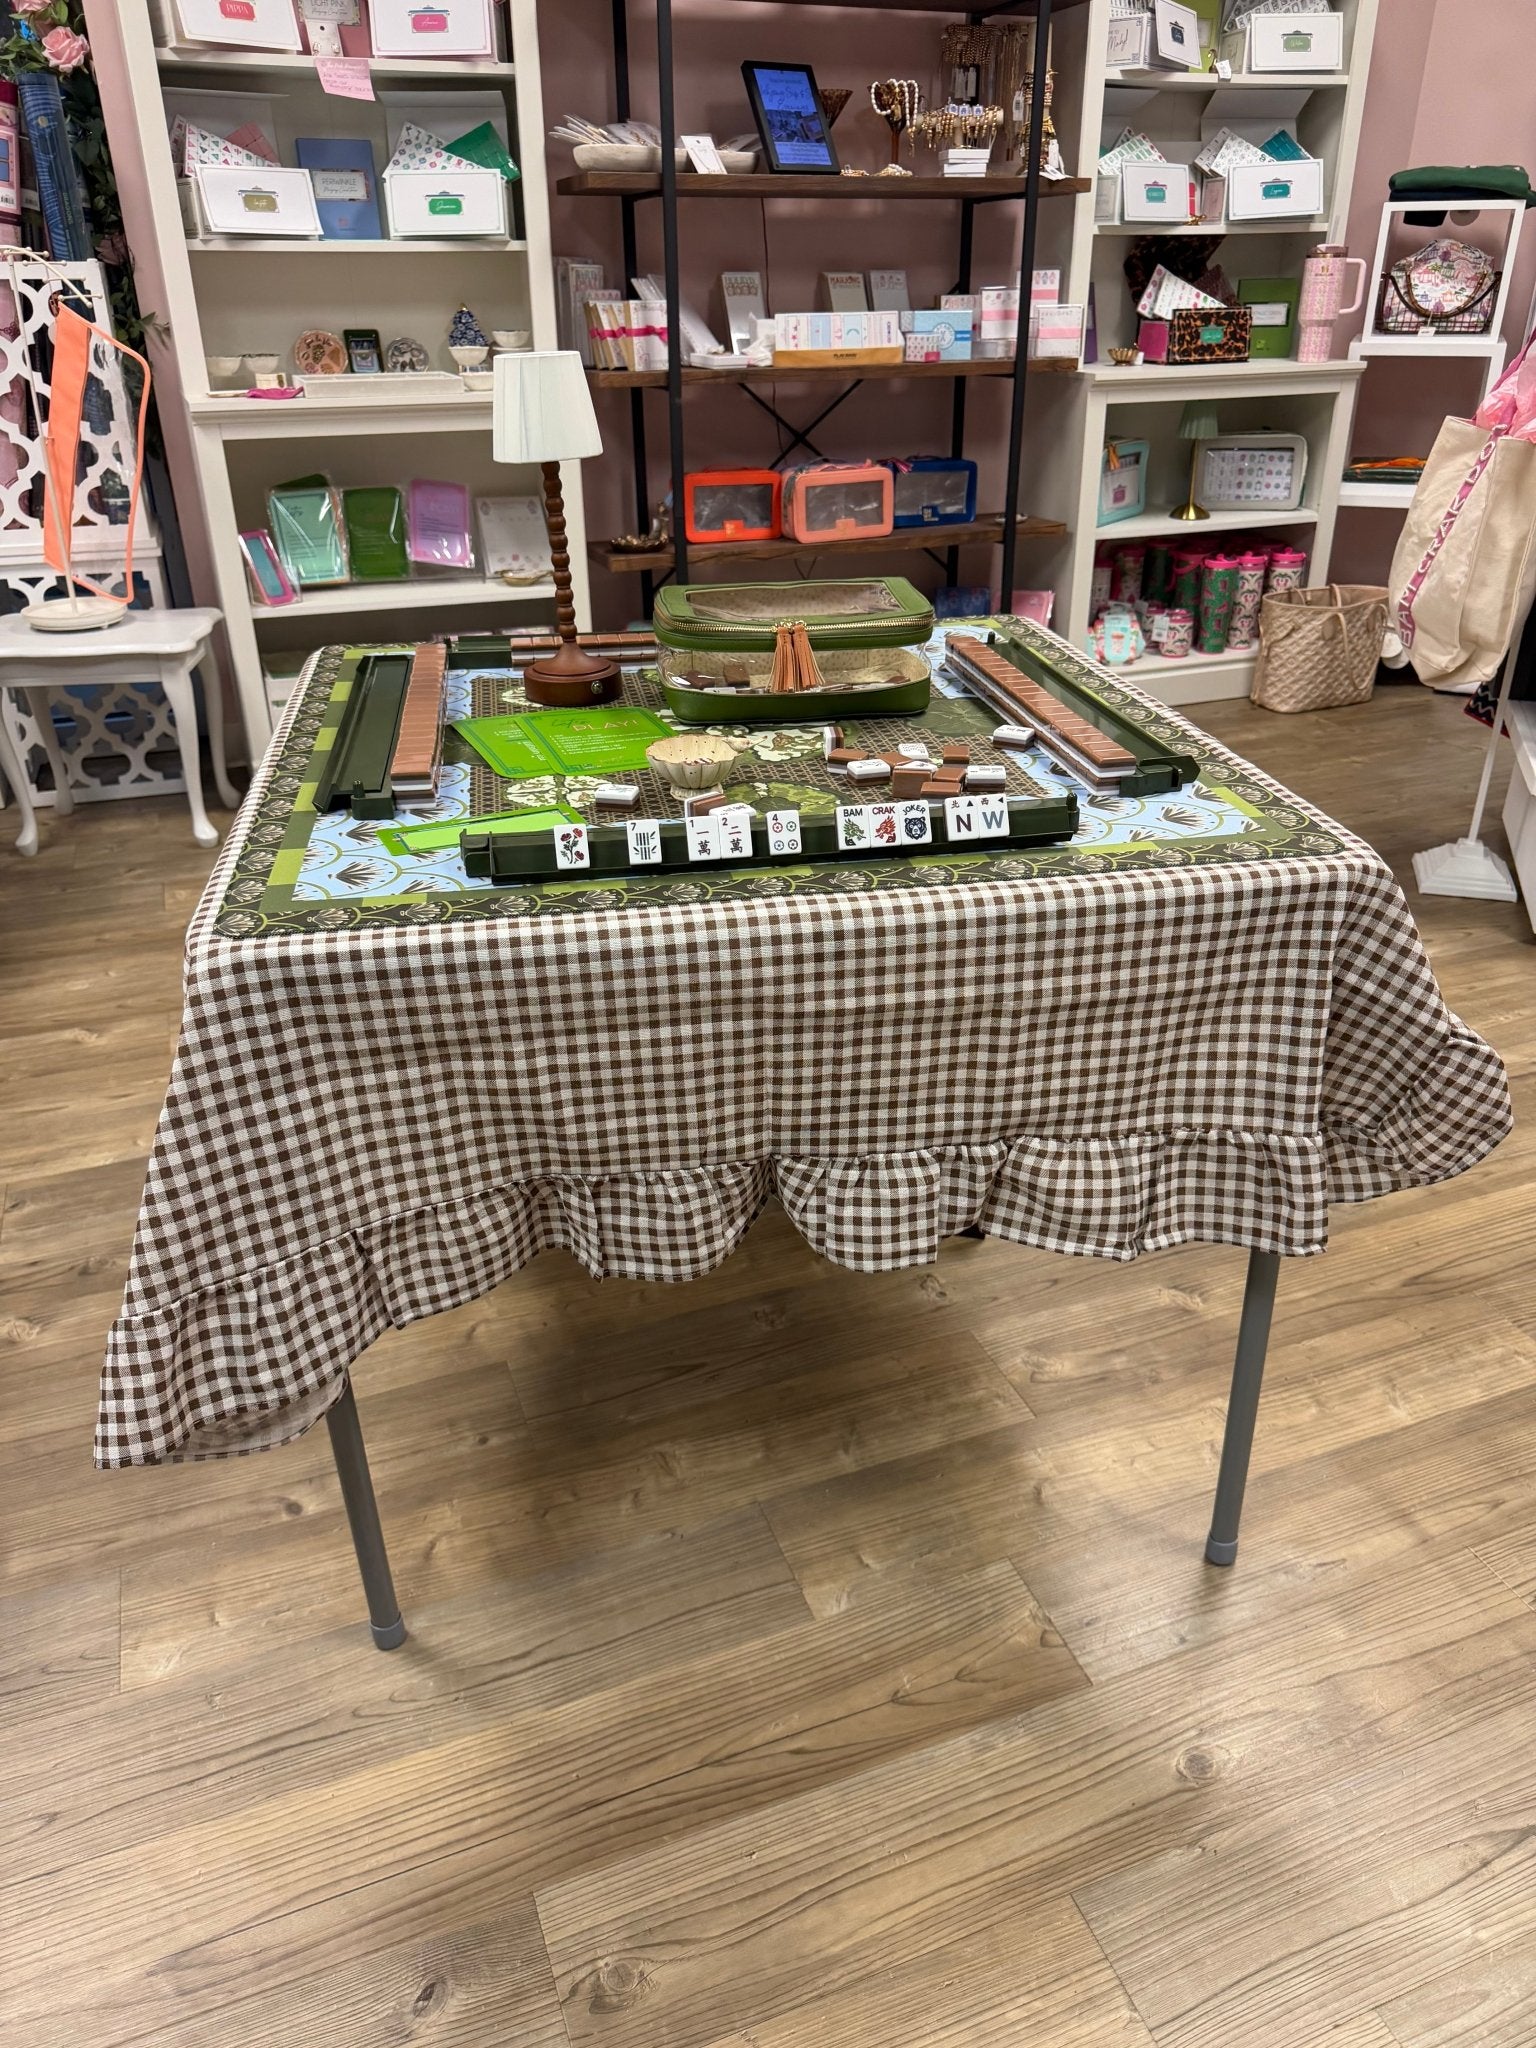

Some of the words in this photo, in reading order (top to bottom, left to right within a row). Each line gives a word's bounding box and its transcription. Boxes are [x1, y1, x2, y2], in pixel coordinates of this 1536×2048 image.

[1416, 494, 1466, 574] CRAK
[1397, 583, 1417, 648] BAM
[572, 720, 638, 732] PLAY!
[951, 800, 960, 809] 北
[980, 797, 989, 806] 西
[843, 808, 863, 817] BAM
[872, 806, 896, 815] CRAK
[902, 804, 926, 815] JOKER
[721, 817, 728, 826] 2
[772, 813, 779, 822] 4
[982, 810, 1005, 830] W
[630, 822, 637, 831] 7
[689, 819, 695, 828] 1
[956, 813, 972, 833] N
